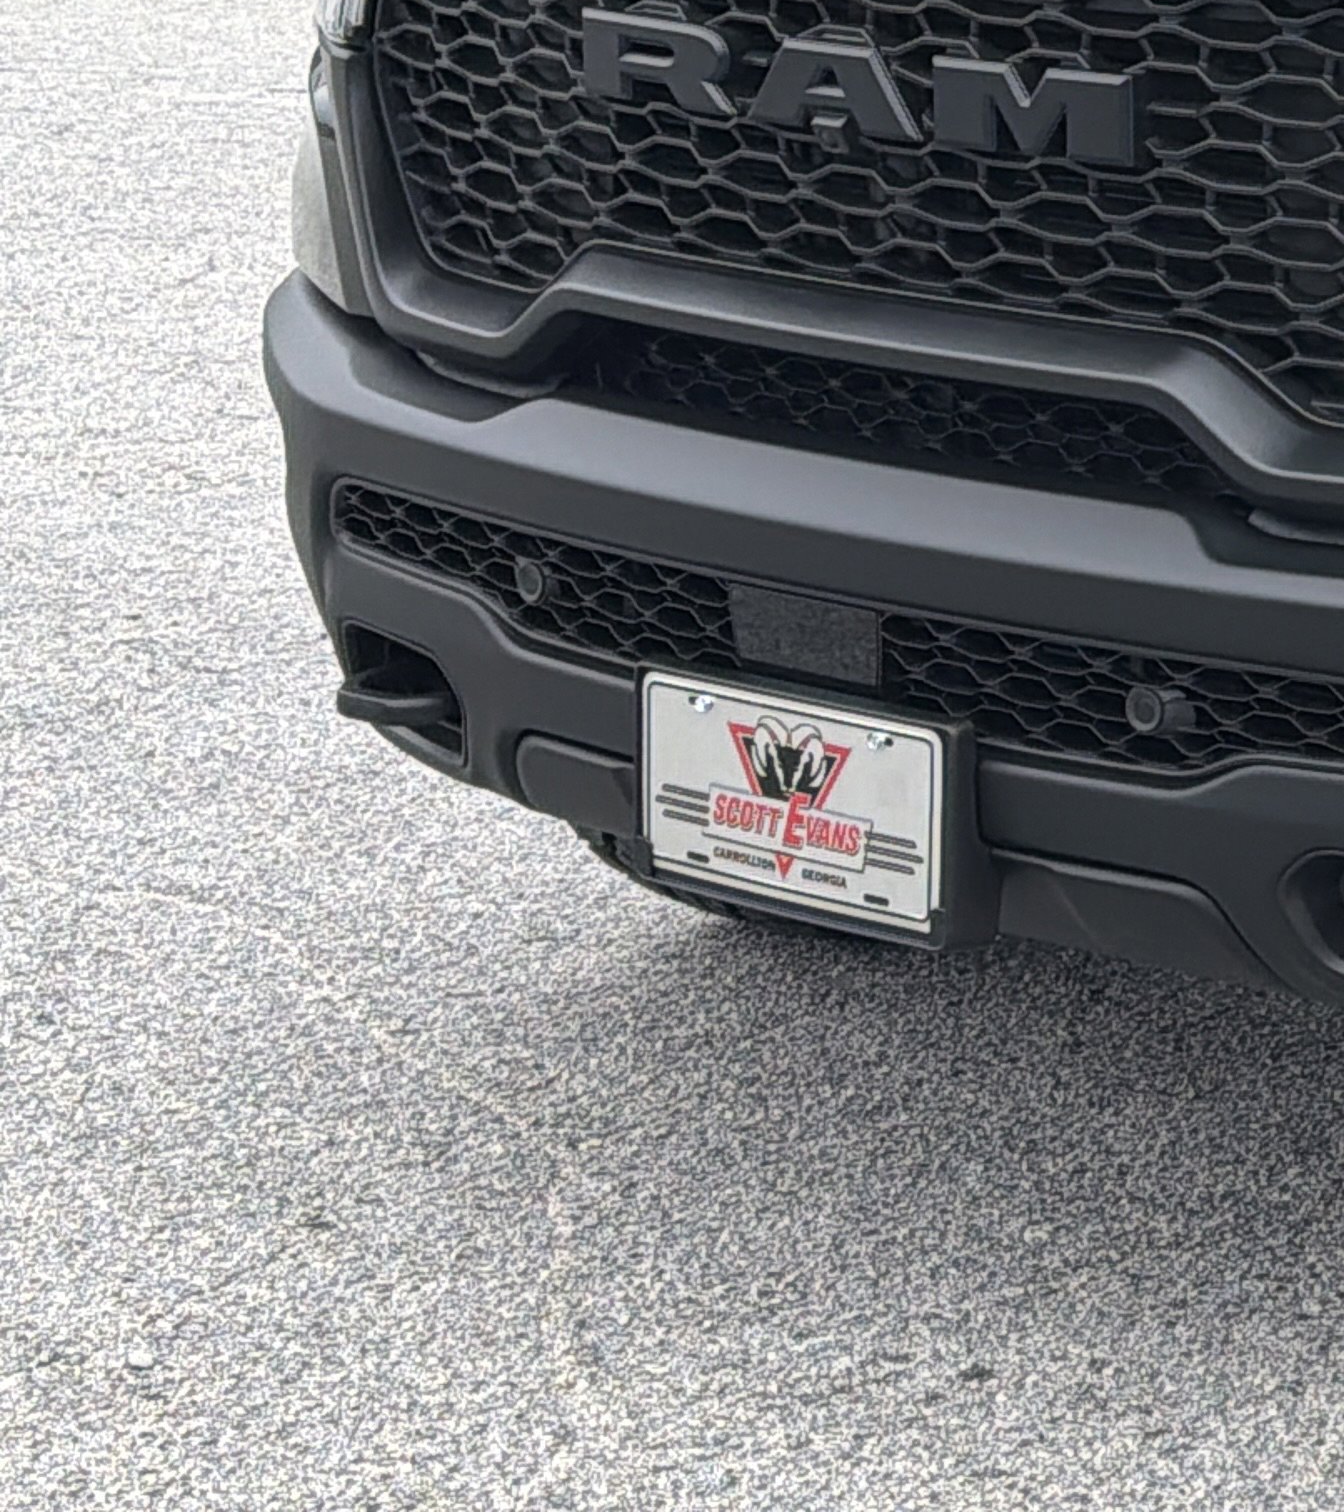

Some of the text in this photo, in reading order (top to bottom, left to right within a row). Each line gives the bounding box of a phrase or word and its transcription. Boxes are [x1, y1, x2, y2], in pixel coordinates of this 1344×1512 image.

[581, 7, 1134, 167] RAM
[713, 791, 861, 856] SCOTT EVANS
[801, 867, 848, 889] GEORGIA
